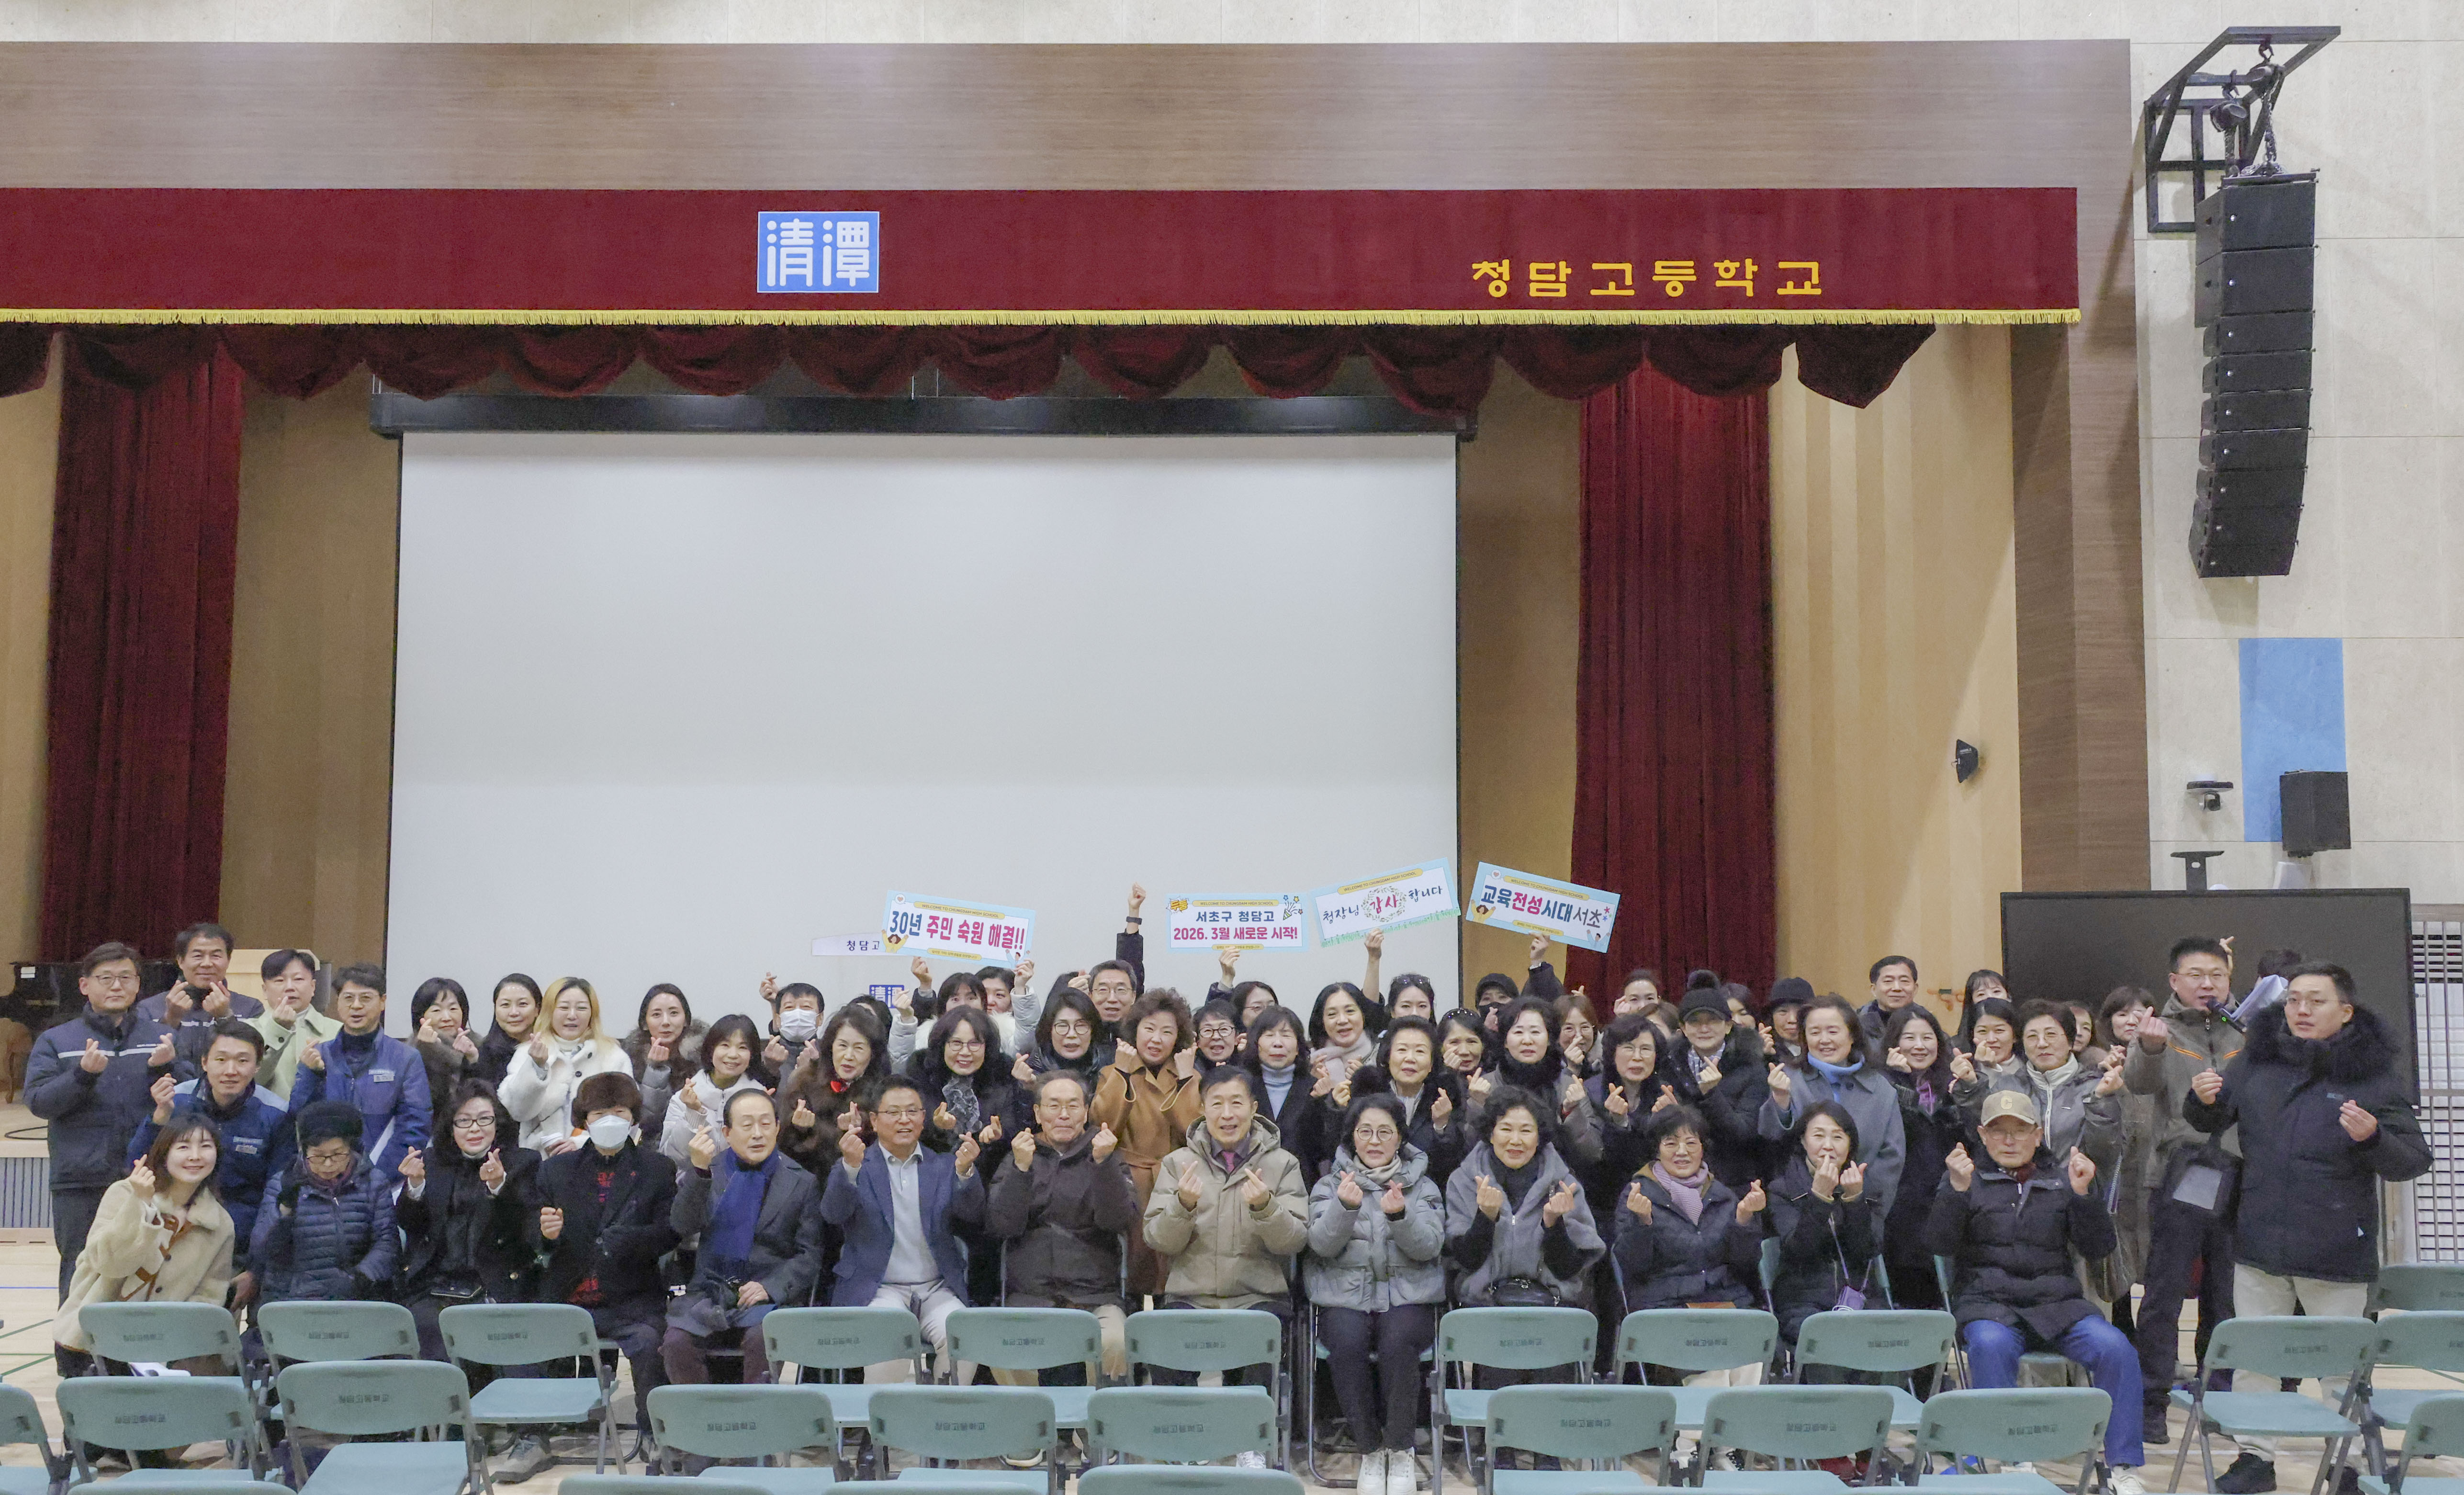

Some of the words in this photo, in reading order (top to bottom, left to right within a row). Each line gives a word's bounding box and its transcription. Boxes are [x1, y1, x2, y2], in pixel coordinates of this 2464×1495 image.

[767, 218, 869, 286] 清潭
[1473, 259, 1821, 297] 청담고등학교
[1196, 911, 1232, 922] 서초구
[1238, 911, 1274, 922] 청담고
[1323, 905, 1359, 924] 청장님
[1370, 894, 1398, 914] 감사
[1408, 885, 1443, 902] 합니다
[890, 911, 922, 936] 30년
[927, 916, 953, 940] 주민
[957, 920, 984, 944] 숙원
[988, 924, 1024, 950] 해결!!
[1174, 928, 1207, 940] 2026.
[1211, 927, 1230, 940] 3월
[1233, 927, 1268, 940] 새로운
[1271, 927, 1297, 939] 시작!
[2001, 1096, 2013, 1110] C
